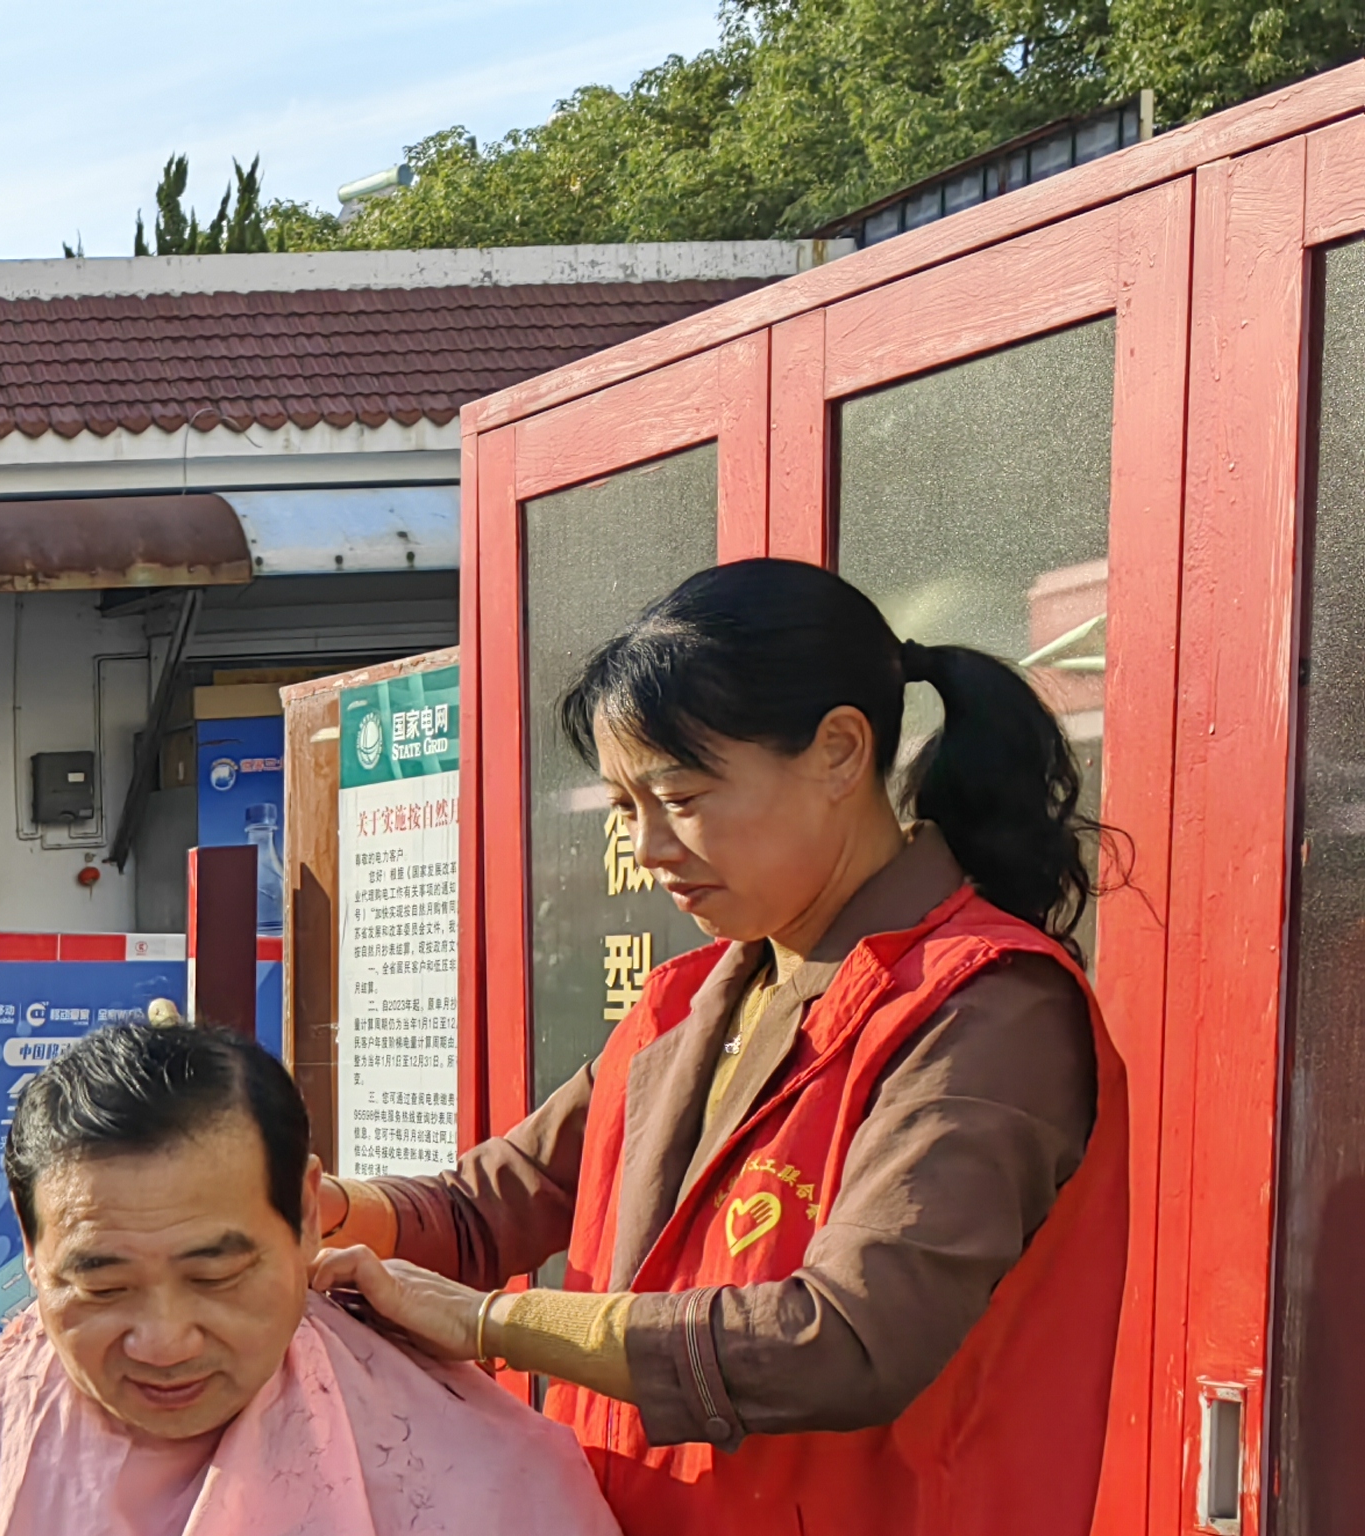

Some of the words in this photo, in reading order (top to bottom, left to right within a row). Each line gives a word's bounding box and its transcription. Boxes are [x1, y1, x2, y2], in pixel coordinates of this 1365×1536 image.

[392, 703, 448, 741] 国家电网
[392, 742, 422, 760] STATE
[423, 737, 448, 755] GRID
[354, 1016, 458, 1031] 量计算周期仍为当年1月1日至12
[354, 1035, 458, 1049] 民客户年度阶梯电量计算周期由
[354, 1054, 458, 1068] 整为当年1月1日至12月31日。所
